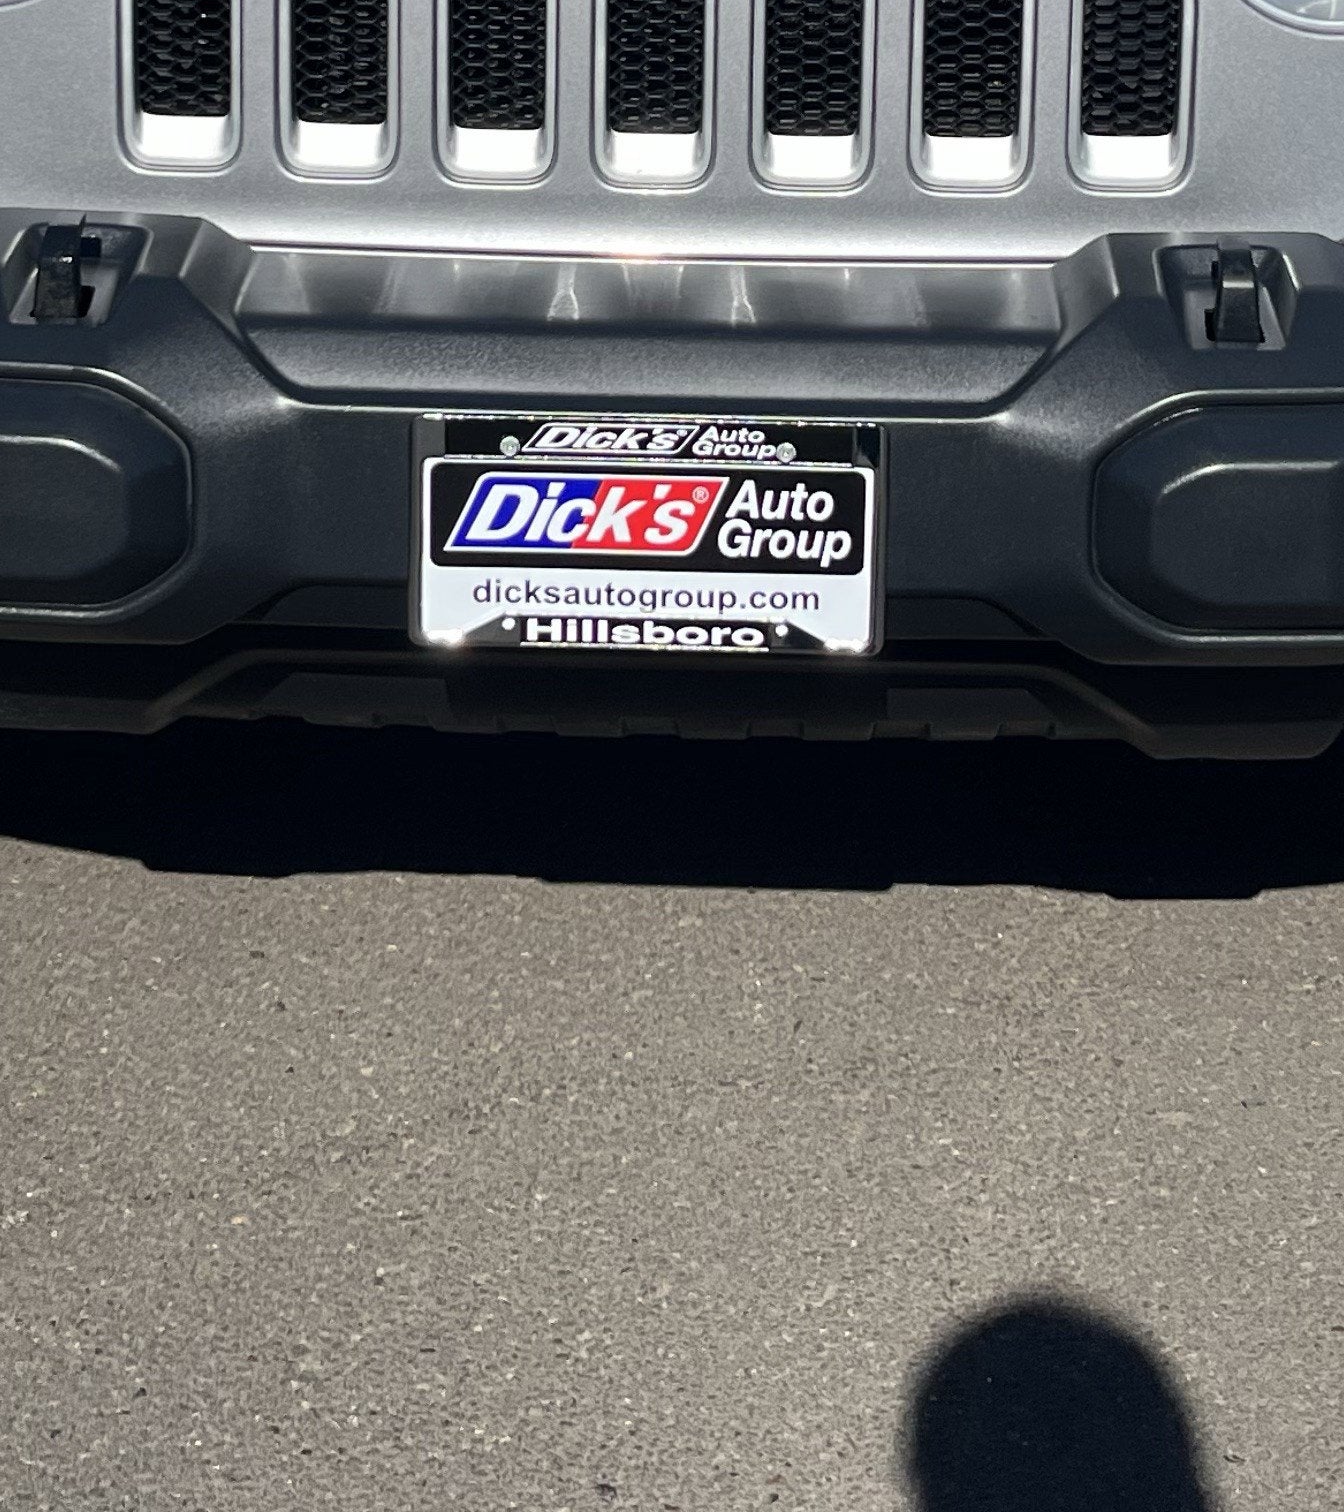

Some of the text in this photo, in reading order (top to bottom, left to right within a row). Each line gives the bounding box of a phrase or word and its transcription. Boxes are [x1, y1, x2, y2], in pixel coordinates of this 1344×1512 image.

[534, 424, 766, 452] Dick's Auto
[692, 441, 777, 460] Group
[465, 480, 835, 545] Dick's Auto
[717, 519, 853, 568] Group
[472, 578, 821, 615] dicksautogroup.com
[525, 617, 766, 647] Hillsboro
